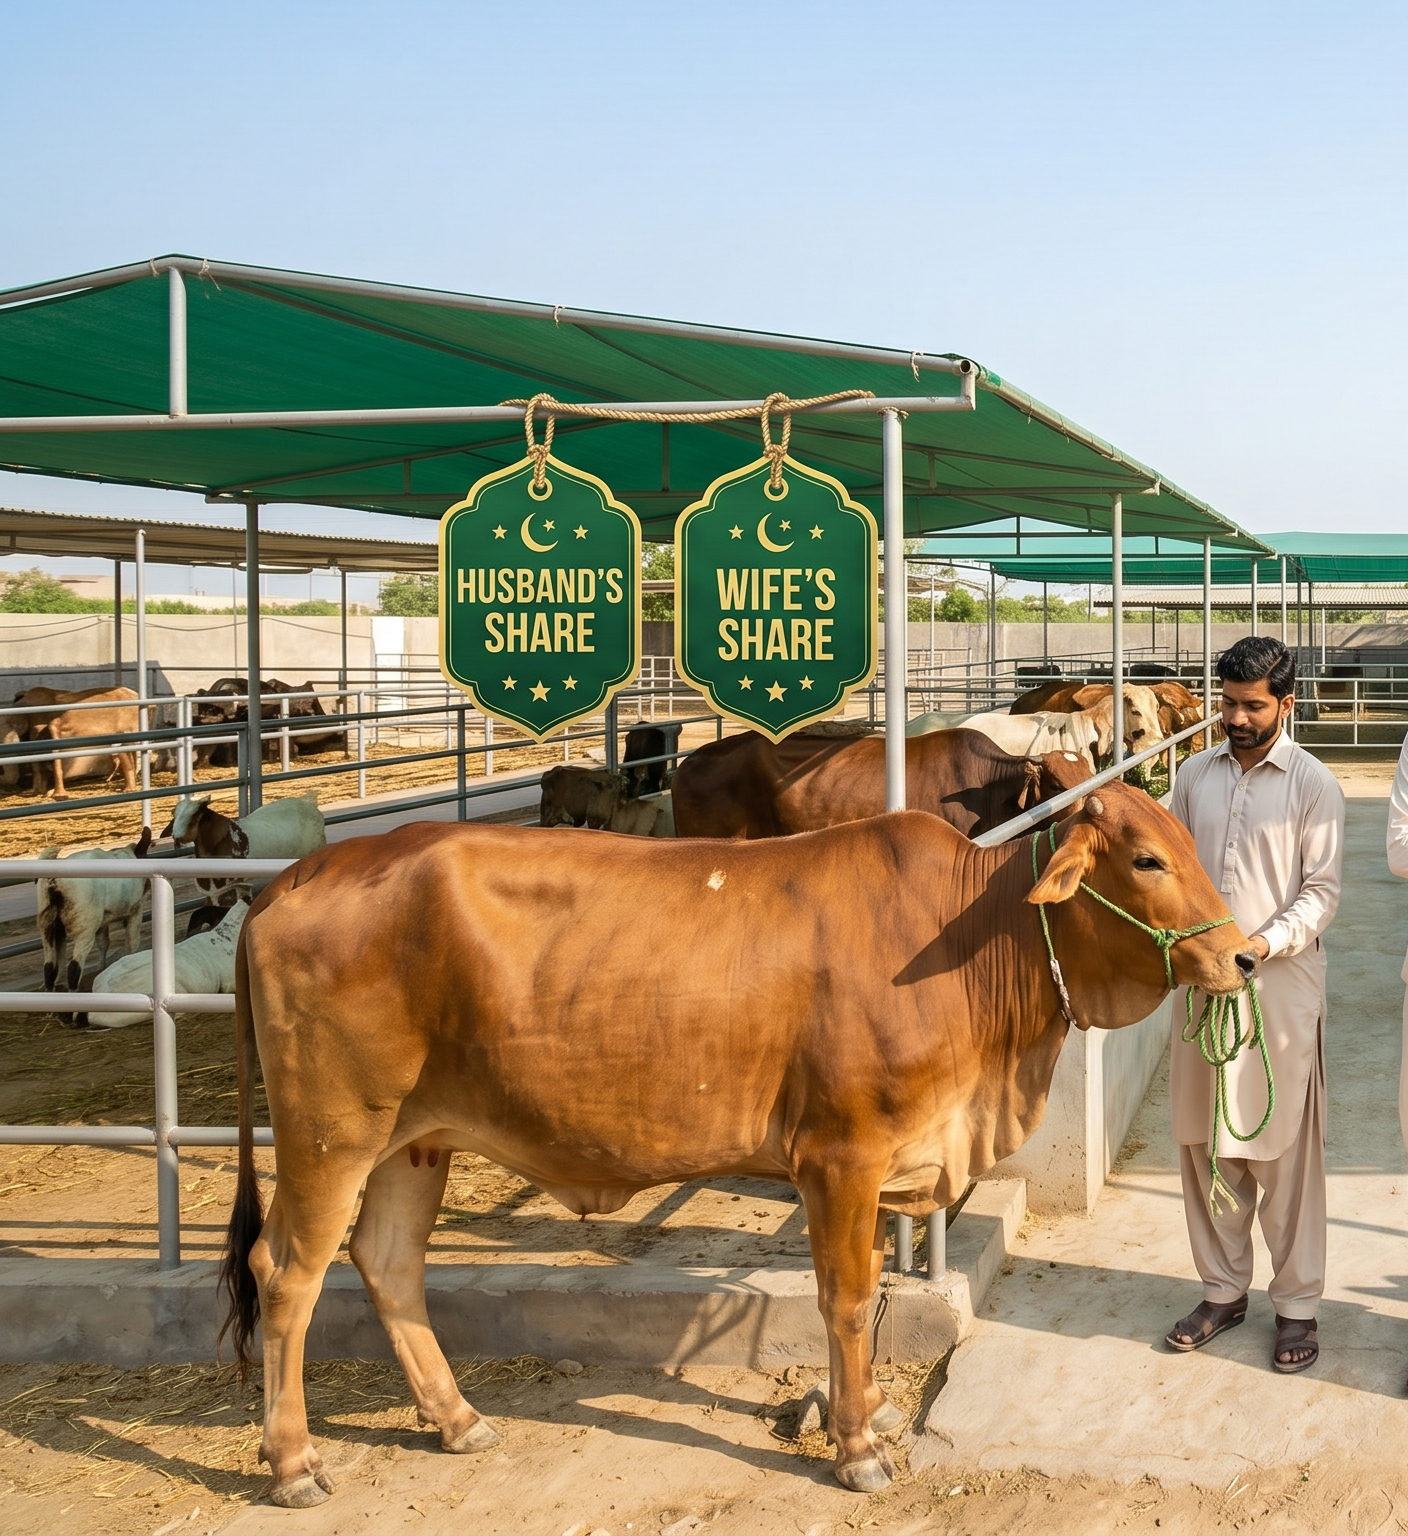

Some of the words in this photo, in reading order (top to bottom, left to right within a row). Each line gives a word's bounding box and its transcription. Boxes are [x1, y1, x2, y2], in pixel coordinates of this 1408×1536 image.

[457, 567, 624, 604] HUSBAND'S
[716, 567, 836, 611] WIFE'S
[484, 611, 595, 653] SHARE
[718, 617, 834, 661] SHARE
